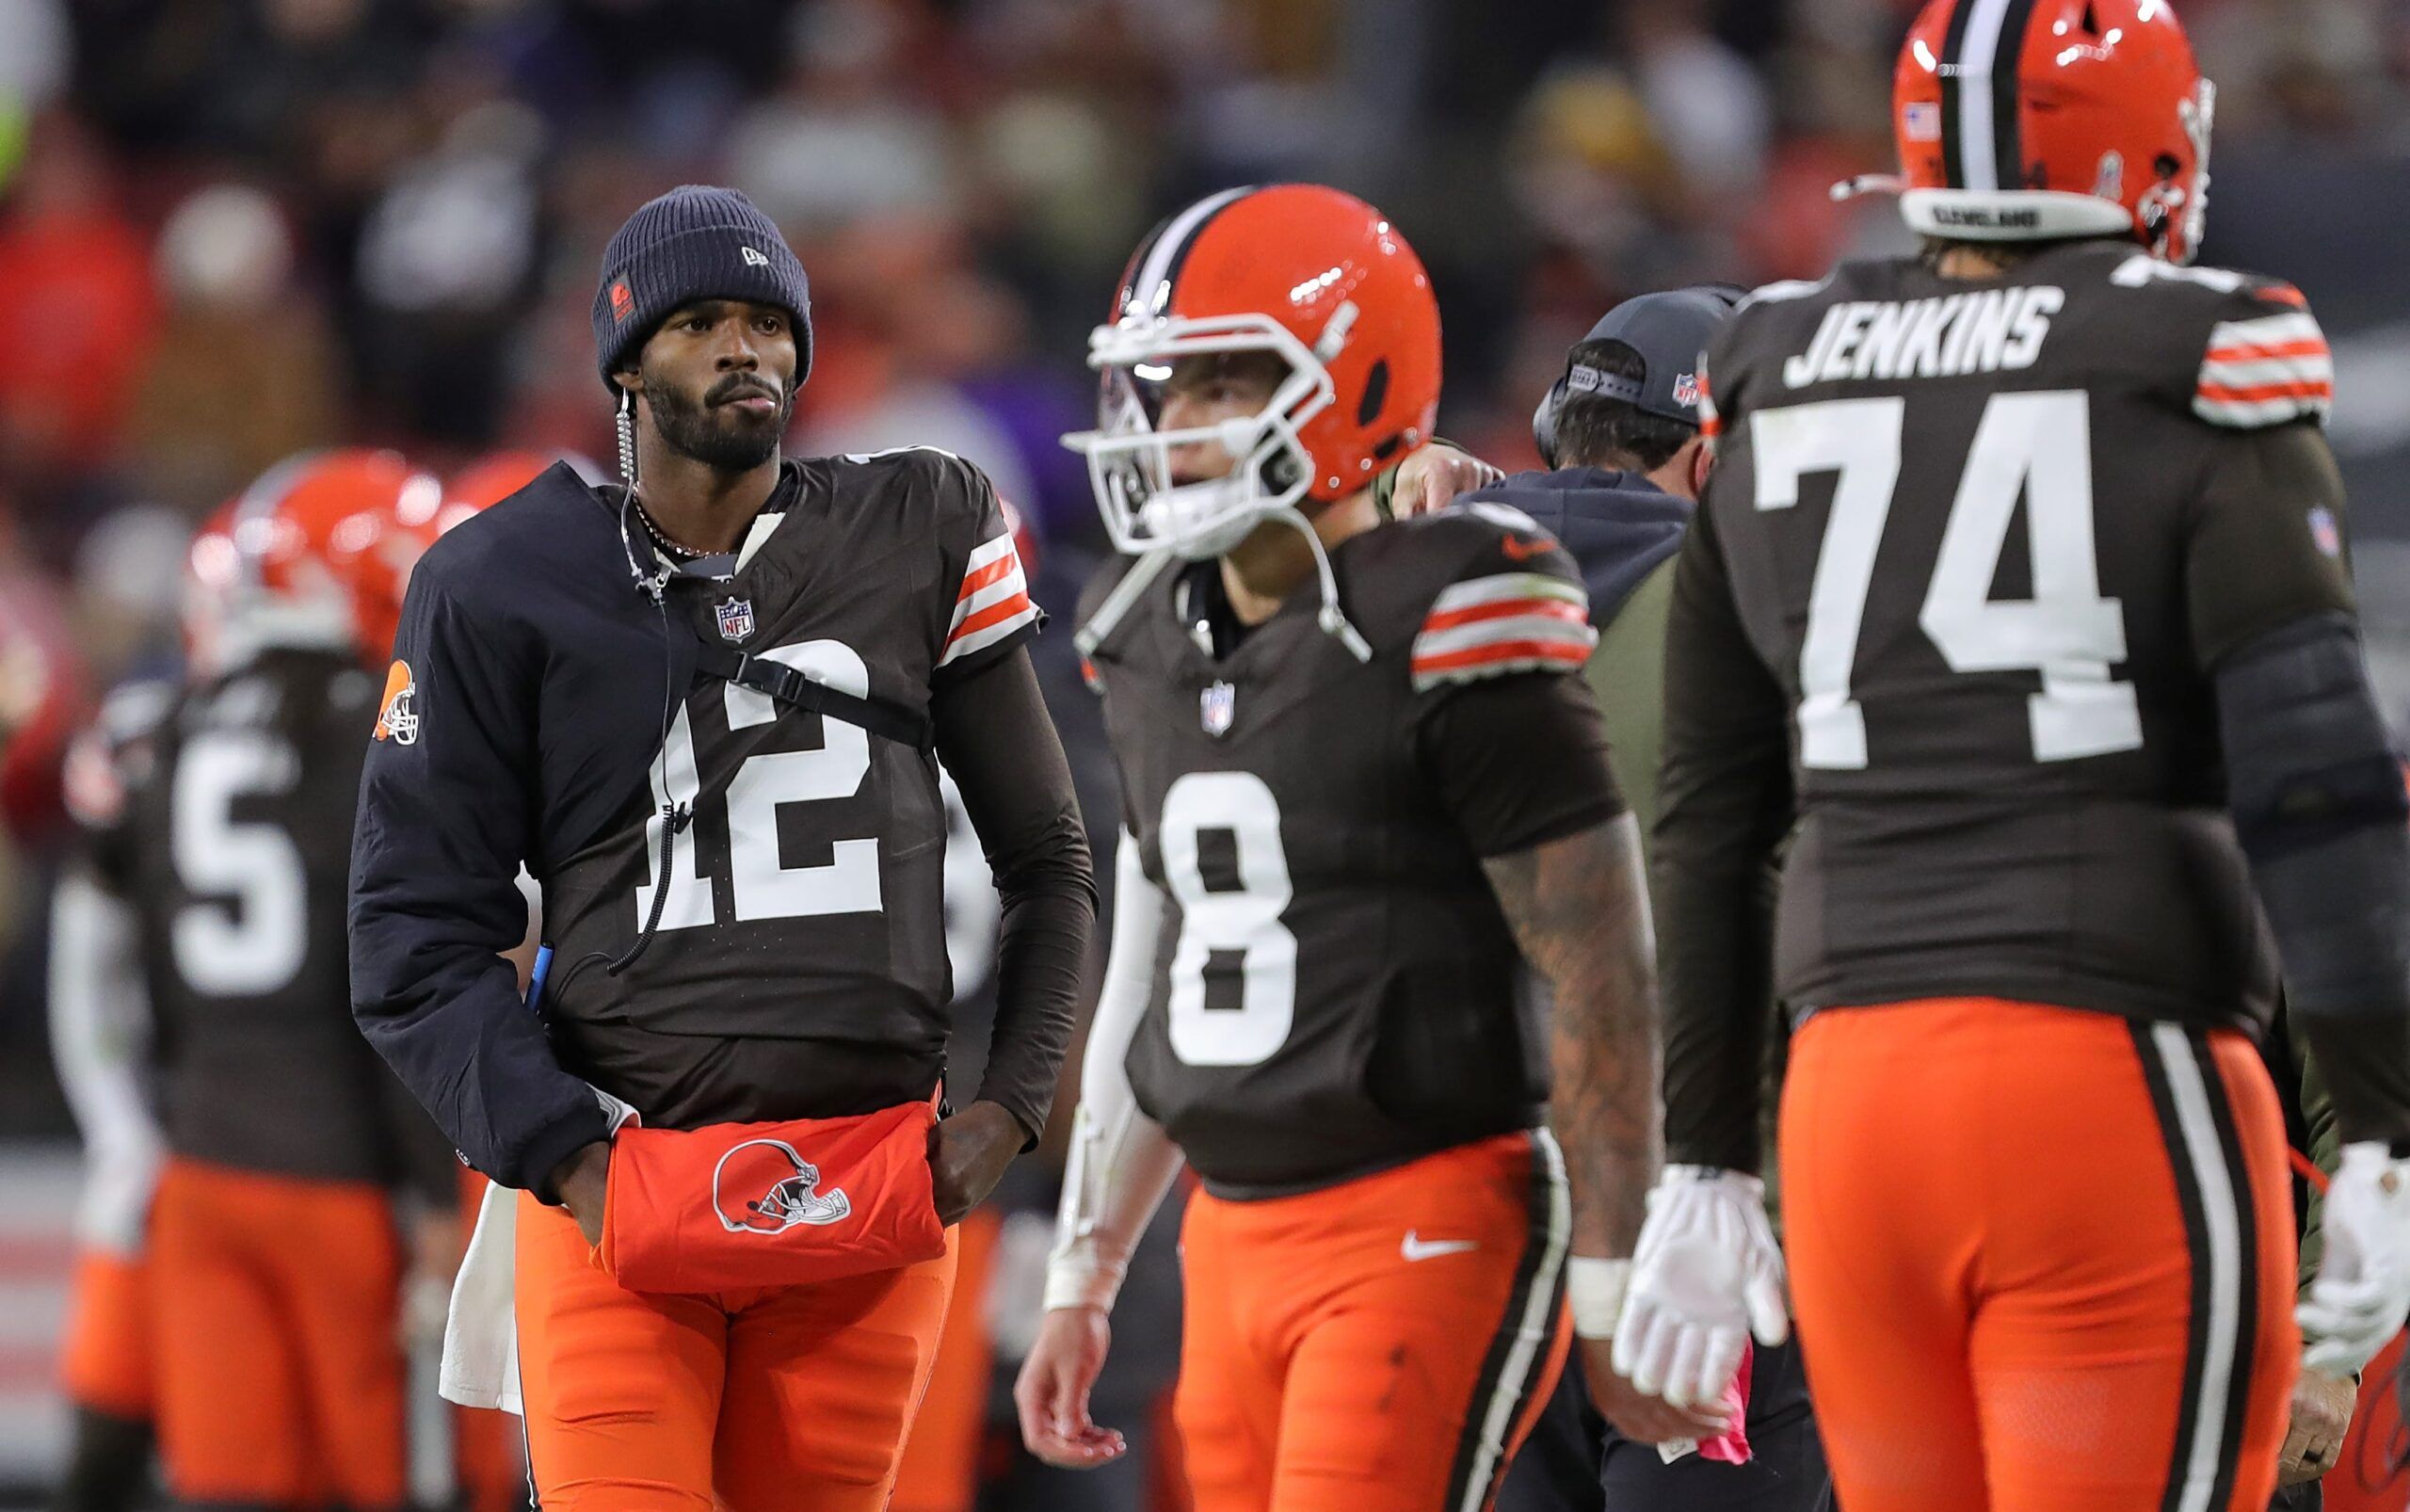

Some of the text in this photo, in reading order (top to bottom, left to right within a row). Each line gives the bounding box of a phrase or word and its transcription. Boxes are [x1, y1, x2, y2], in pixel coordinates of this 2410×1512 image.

[1784, 285, 2065, 389] JENKINS
[724, 617, 750, 635] NFL
[1750, 389, 2145, 769] 74
[171, 727, 308, 994] 5
[635, 638, 883, 935] 12
[1161, 771, 1298, 1066] 8
